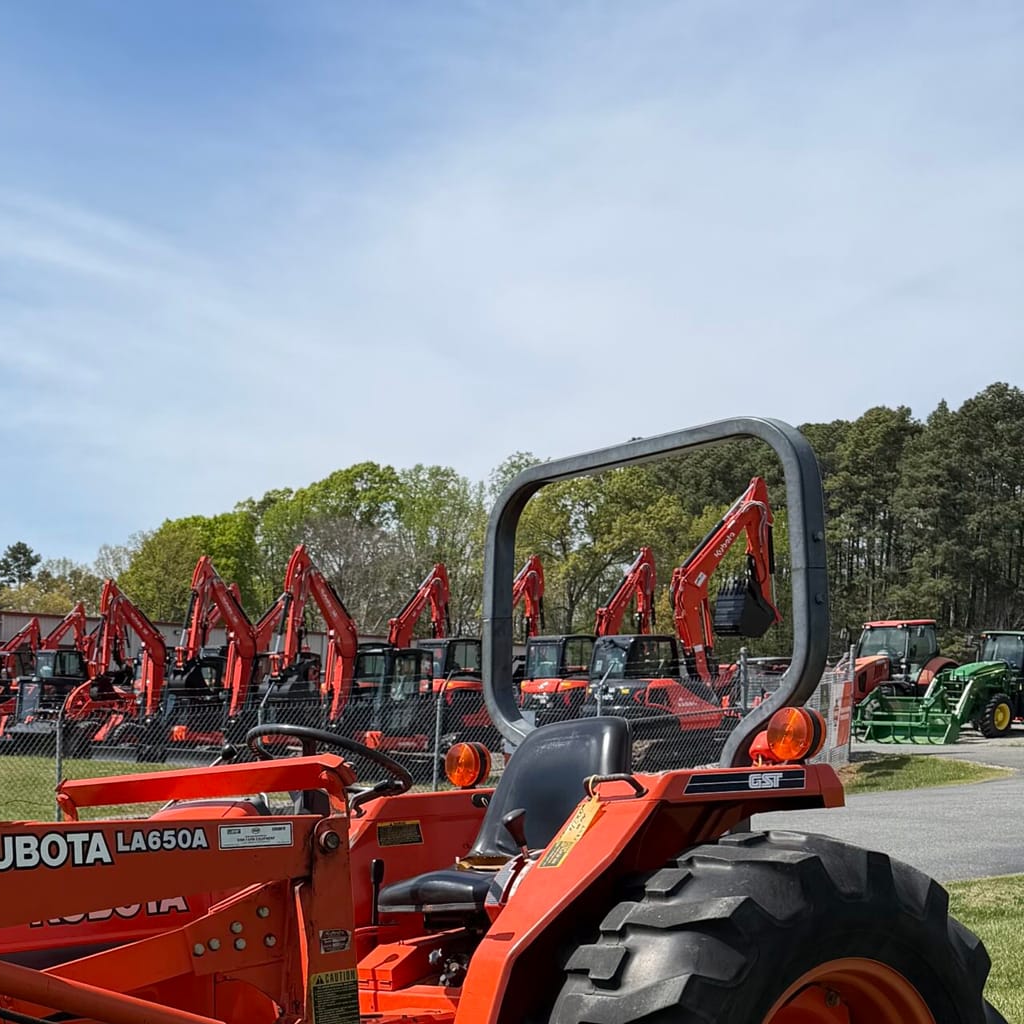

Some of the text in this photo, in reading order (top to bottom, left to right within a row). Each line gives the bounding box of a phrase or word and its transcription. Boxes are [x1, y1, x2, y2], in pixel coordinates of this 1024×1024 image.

[713, 532, 736, 558] Kubota
[748, 772, 784, 789] GST
[116, 828, 209, 852] LA650A
[326, 969, 356, 984] CAUTION
